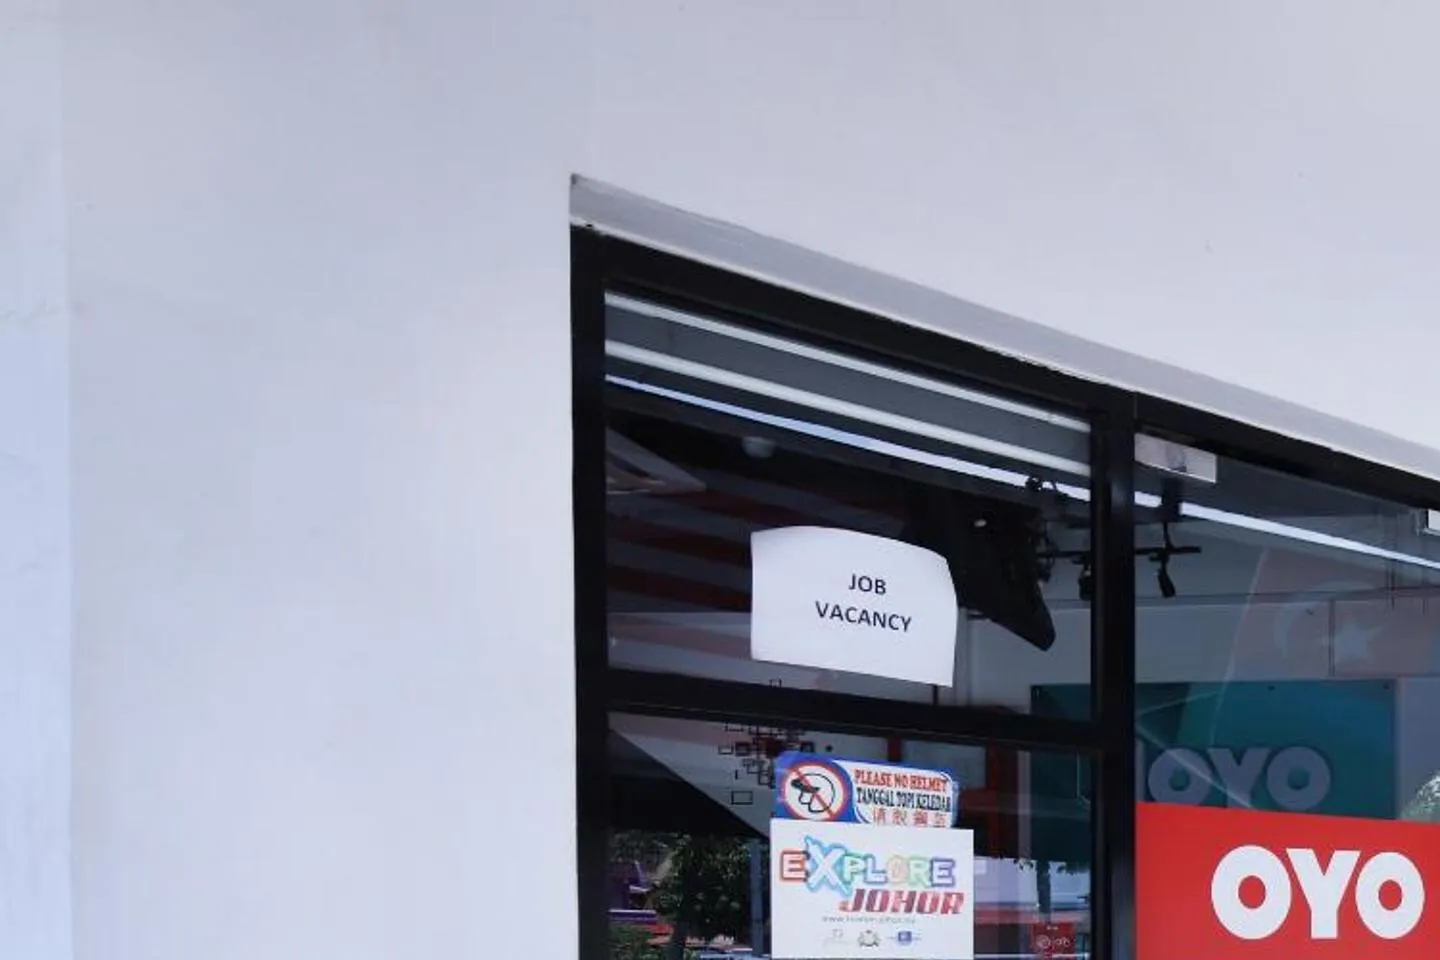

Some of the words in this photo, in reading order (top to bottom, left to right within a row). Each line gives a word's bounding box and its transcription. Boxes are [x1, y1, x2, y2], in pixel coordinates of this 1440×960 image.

[849, 574, 887, 595] JOB
[815, 601, 912, 632] VACANCY
[854, 769, 892, 787] PLEASE
[894, 773, 909, 788] NO
[910, 775, 948, 792] HELMET
[1147, 746, 1332, 810] OYO
[838, 888, 965, 915] JOHOR
[1211, 845, 1425, 939] OYO
